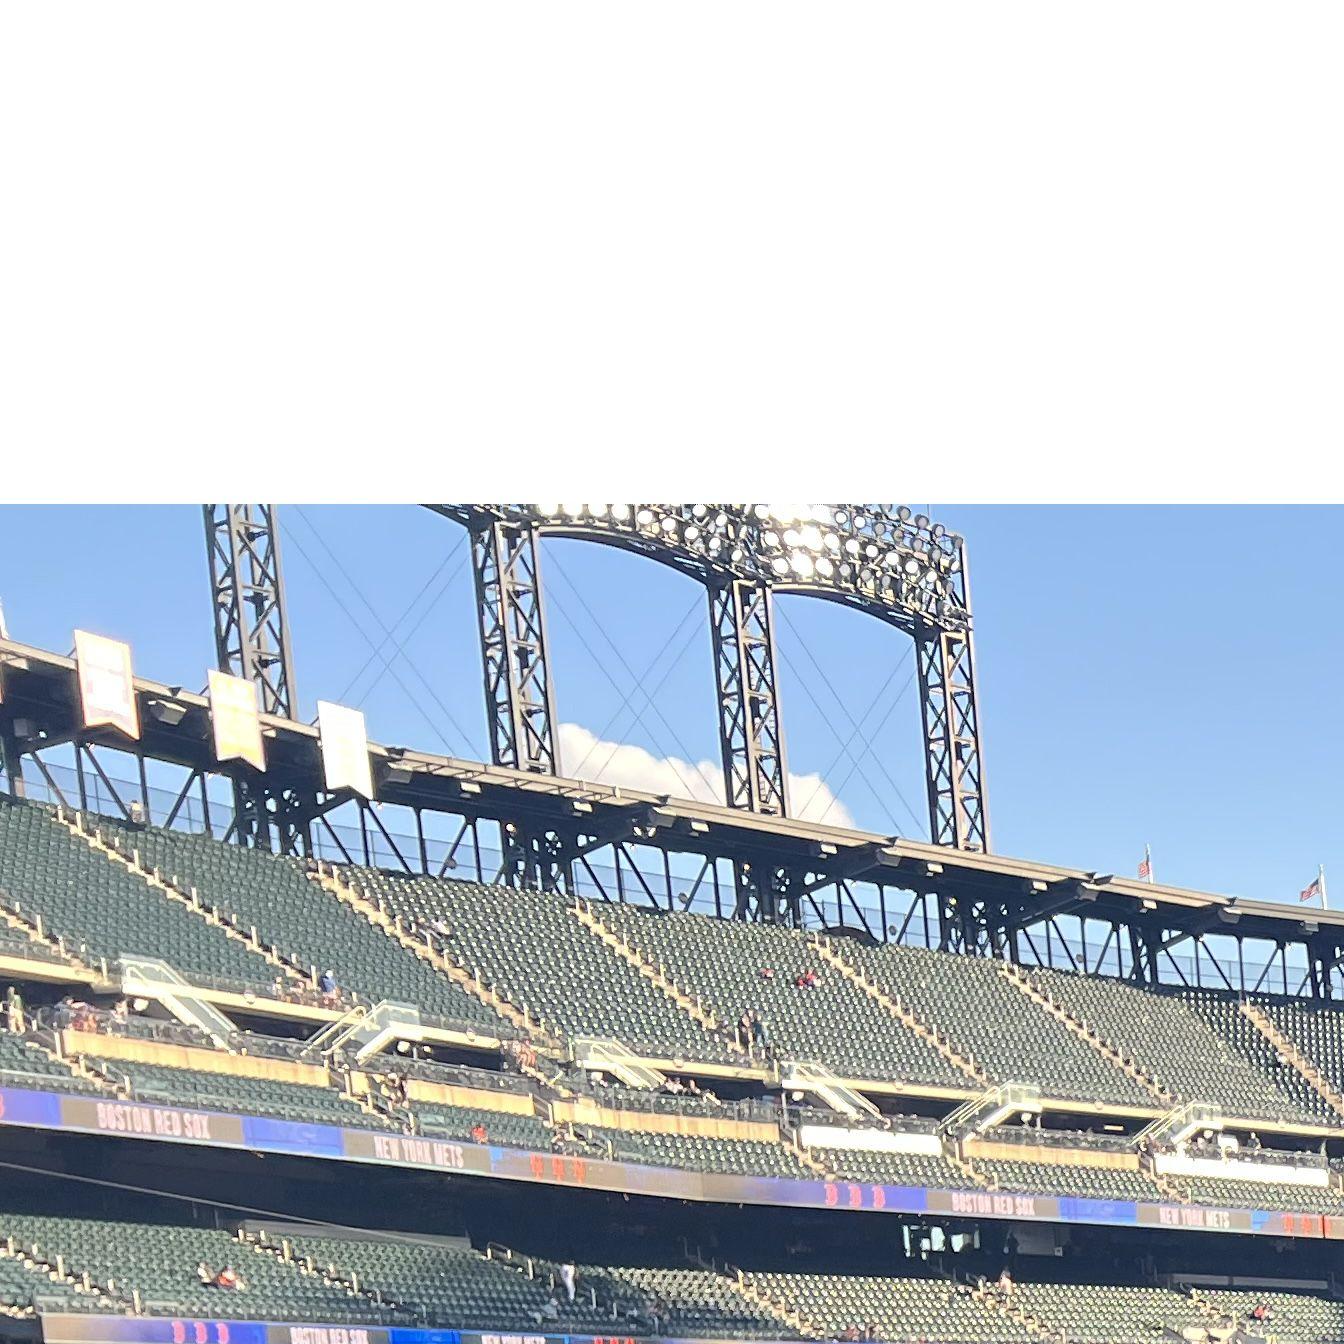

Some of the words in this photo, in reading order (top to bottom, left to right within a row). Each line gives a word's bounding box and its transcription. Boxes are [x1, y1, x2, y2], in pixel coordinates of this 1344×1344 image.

[96, 1102, 150, 1133] BOSTON
[154, 1109, 181, 1136] RED
[183, 1113, 211, 1139] SOX
[374, 1136, 400, 1160] NEW
[401, 1138, 432, 1164] YORK
[432, 1142, 464, 1168] METS
[951, 1192, 992, 1213] BOSTON
[994, 1195, 1014, 1215] RED
[1015, 1197, 1036, 1216] SOX
